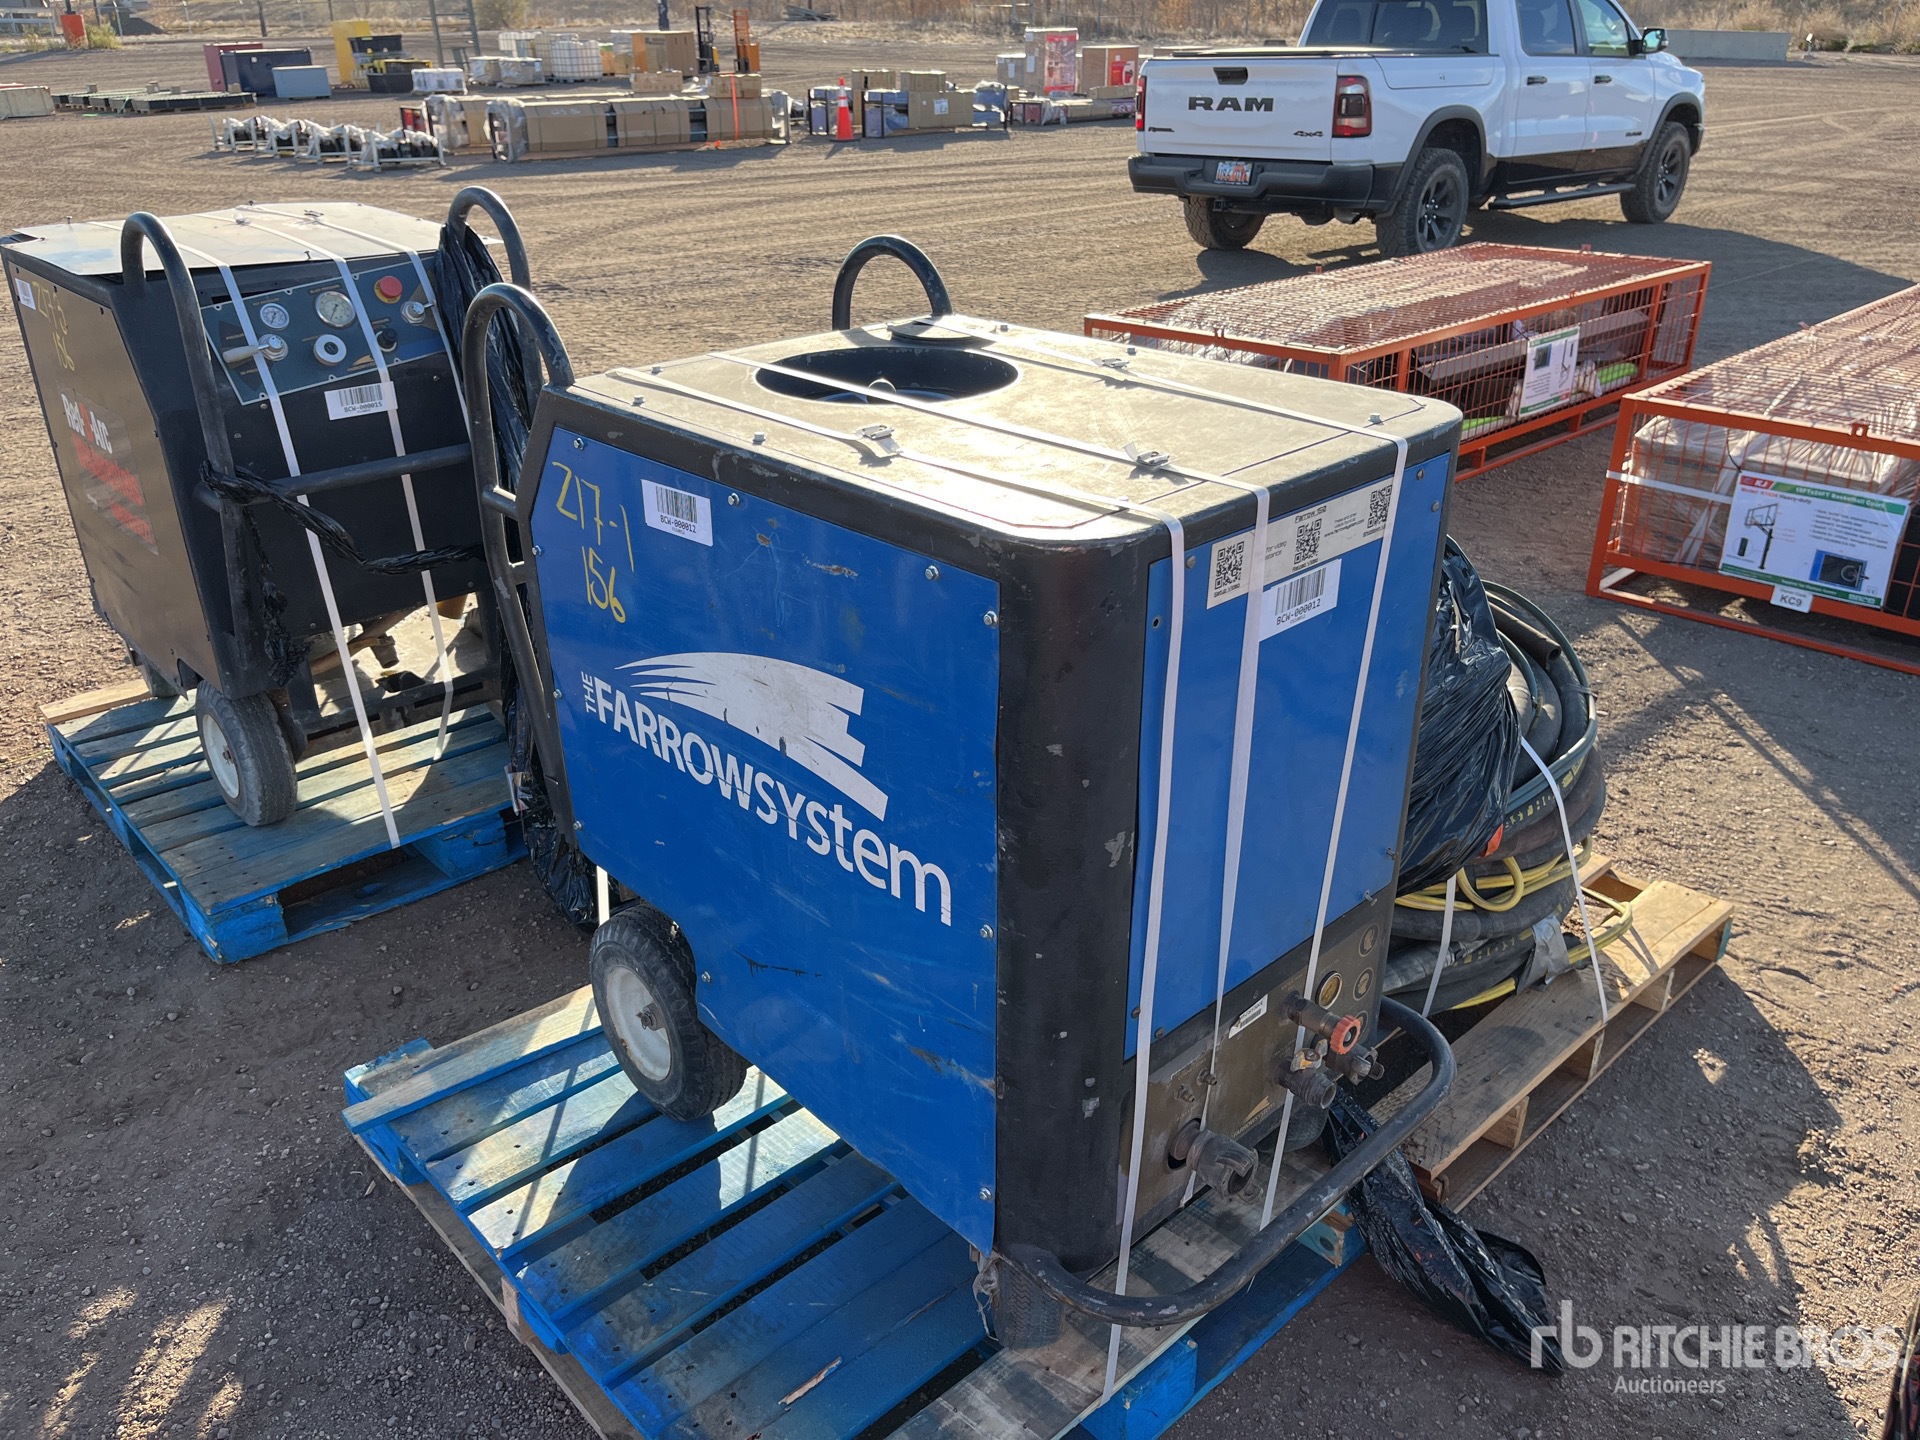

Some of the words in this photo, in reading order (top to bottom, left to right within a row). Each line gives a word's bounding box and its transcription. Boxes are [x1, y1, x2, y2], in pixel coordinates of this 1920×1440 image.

[1188, 96, 1274, 112] RAM
[1293, 130, 1324, 138] 4x4
[660, 514, 697, 534] BCW-000012
[581, 545, 626, 623] 156
[1779, 594, 1803, 607] KC9
[1276, 598, 1321, 626] BCW-000012
[580, 671, 597, 714] THE
